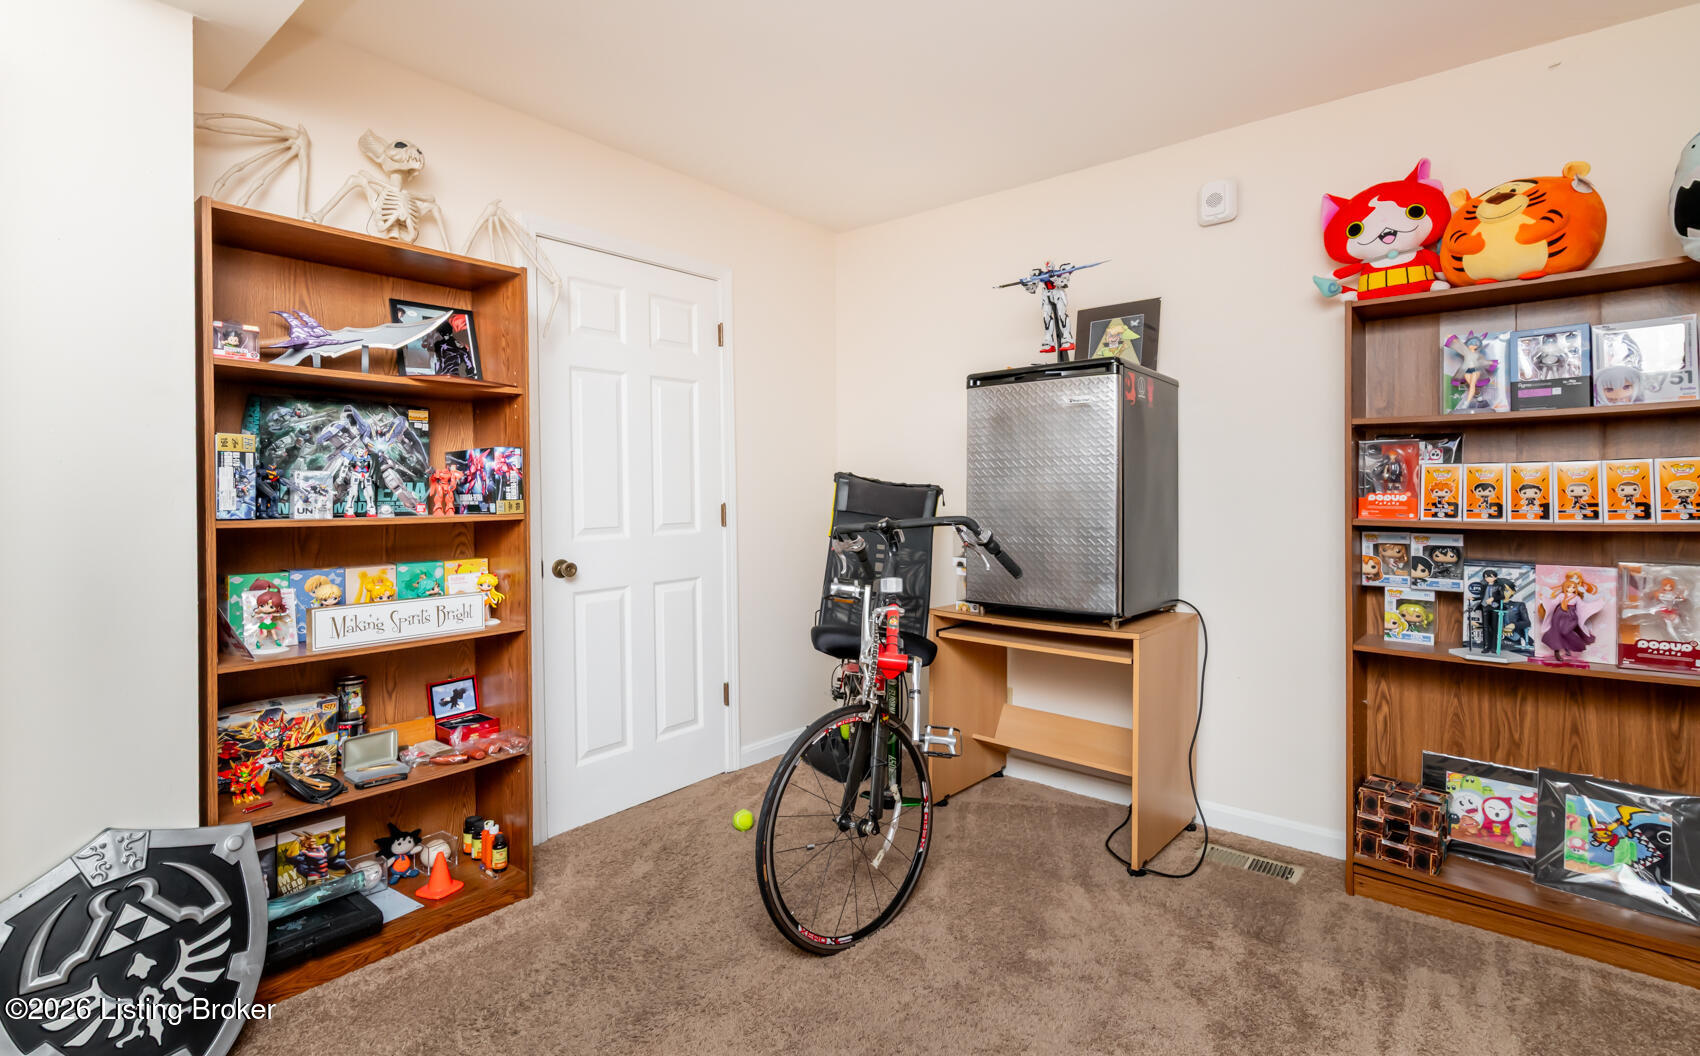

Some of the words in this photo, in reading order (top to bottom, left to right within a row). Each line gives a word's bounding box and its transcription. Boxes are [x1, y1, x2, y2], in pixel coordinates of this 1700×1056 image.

[329, 614, 385, 640] Making
[436, 602, 473, 628] Bright
[278, 867, 298, 887] MY
[280, 877, 303, 894] HERO
